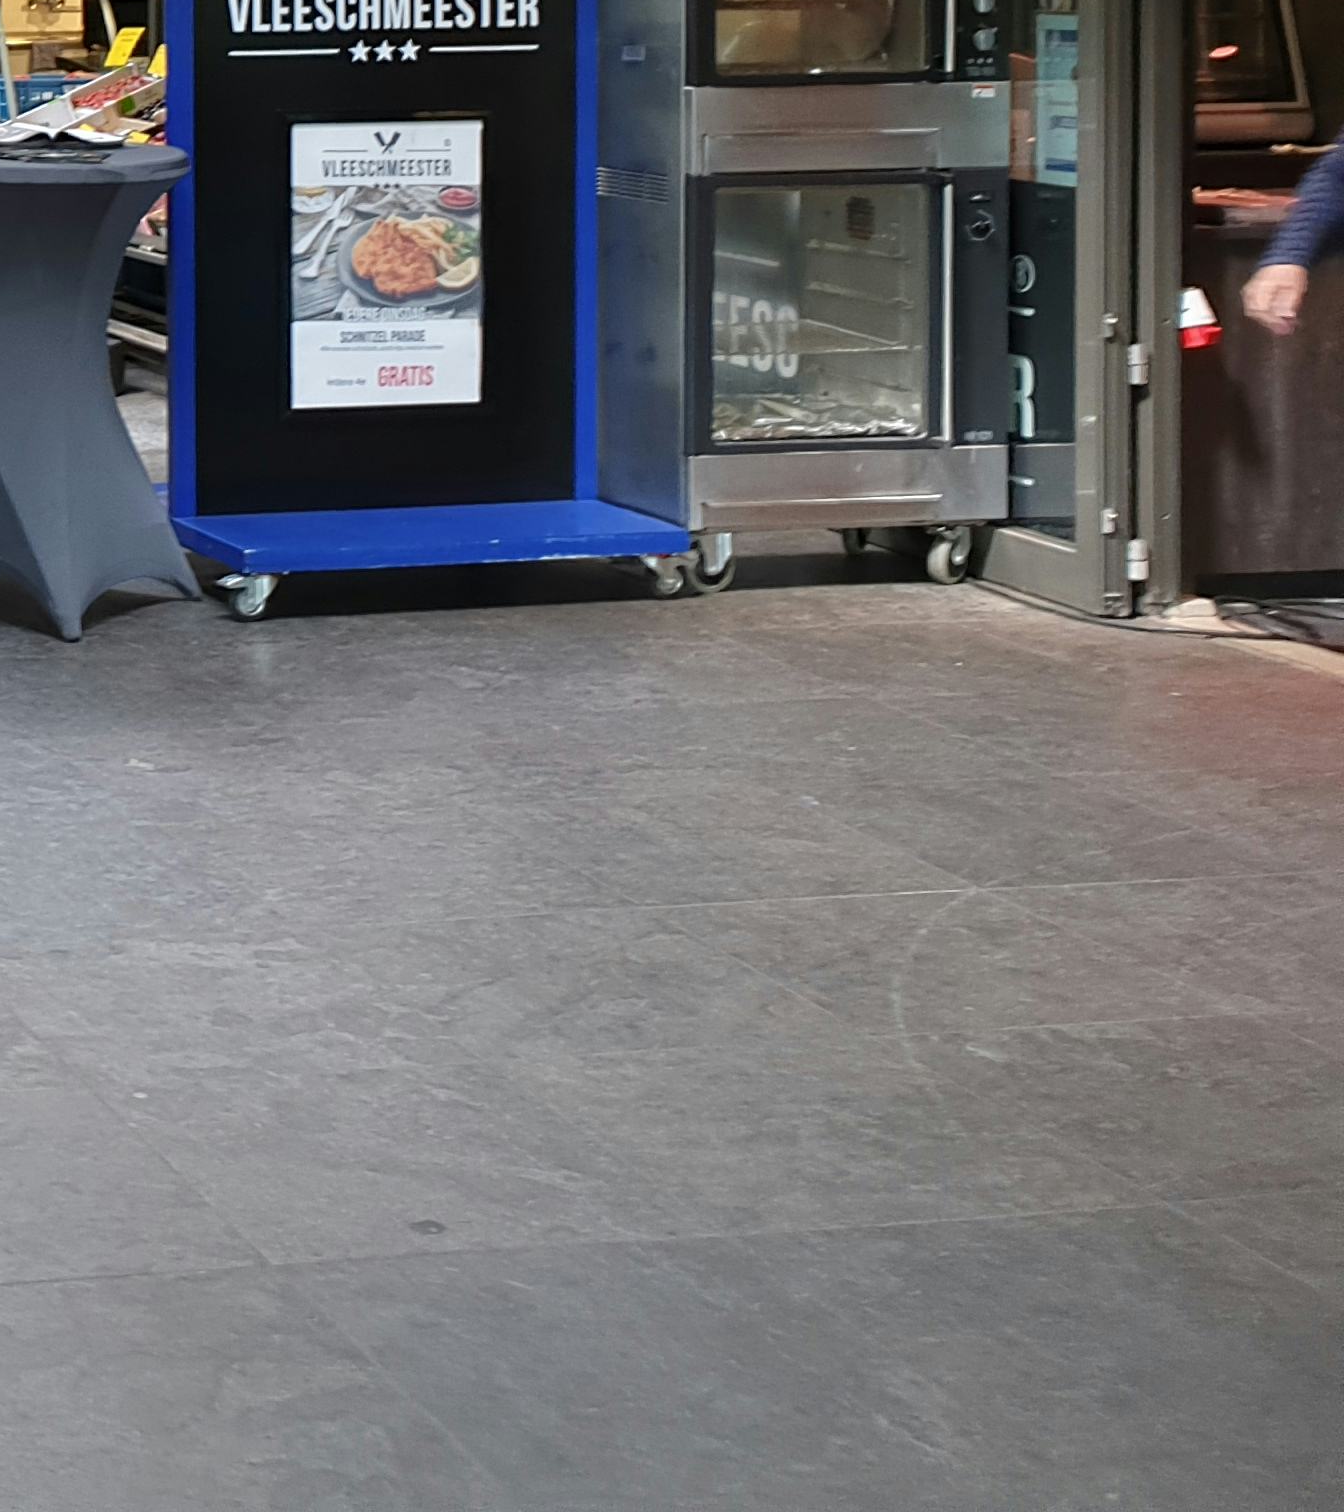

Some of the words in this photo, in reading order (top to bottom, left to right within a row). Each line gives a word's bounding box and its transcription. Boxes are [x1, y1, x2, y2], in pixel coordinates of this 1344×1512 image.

[322, 159, 452, 178] VLEESCHMEESTER
[391, 330, 425, 342] PARADE
[378, 365, 434, 386] GRATIS
